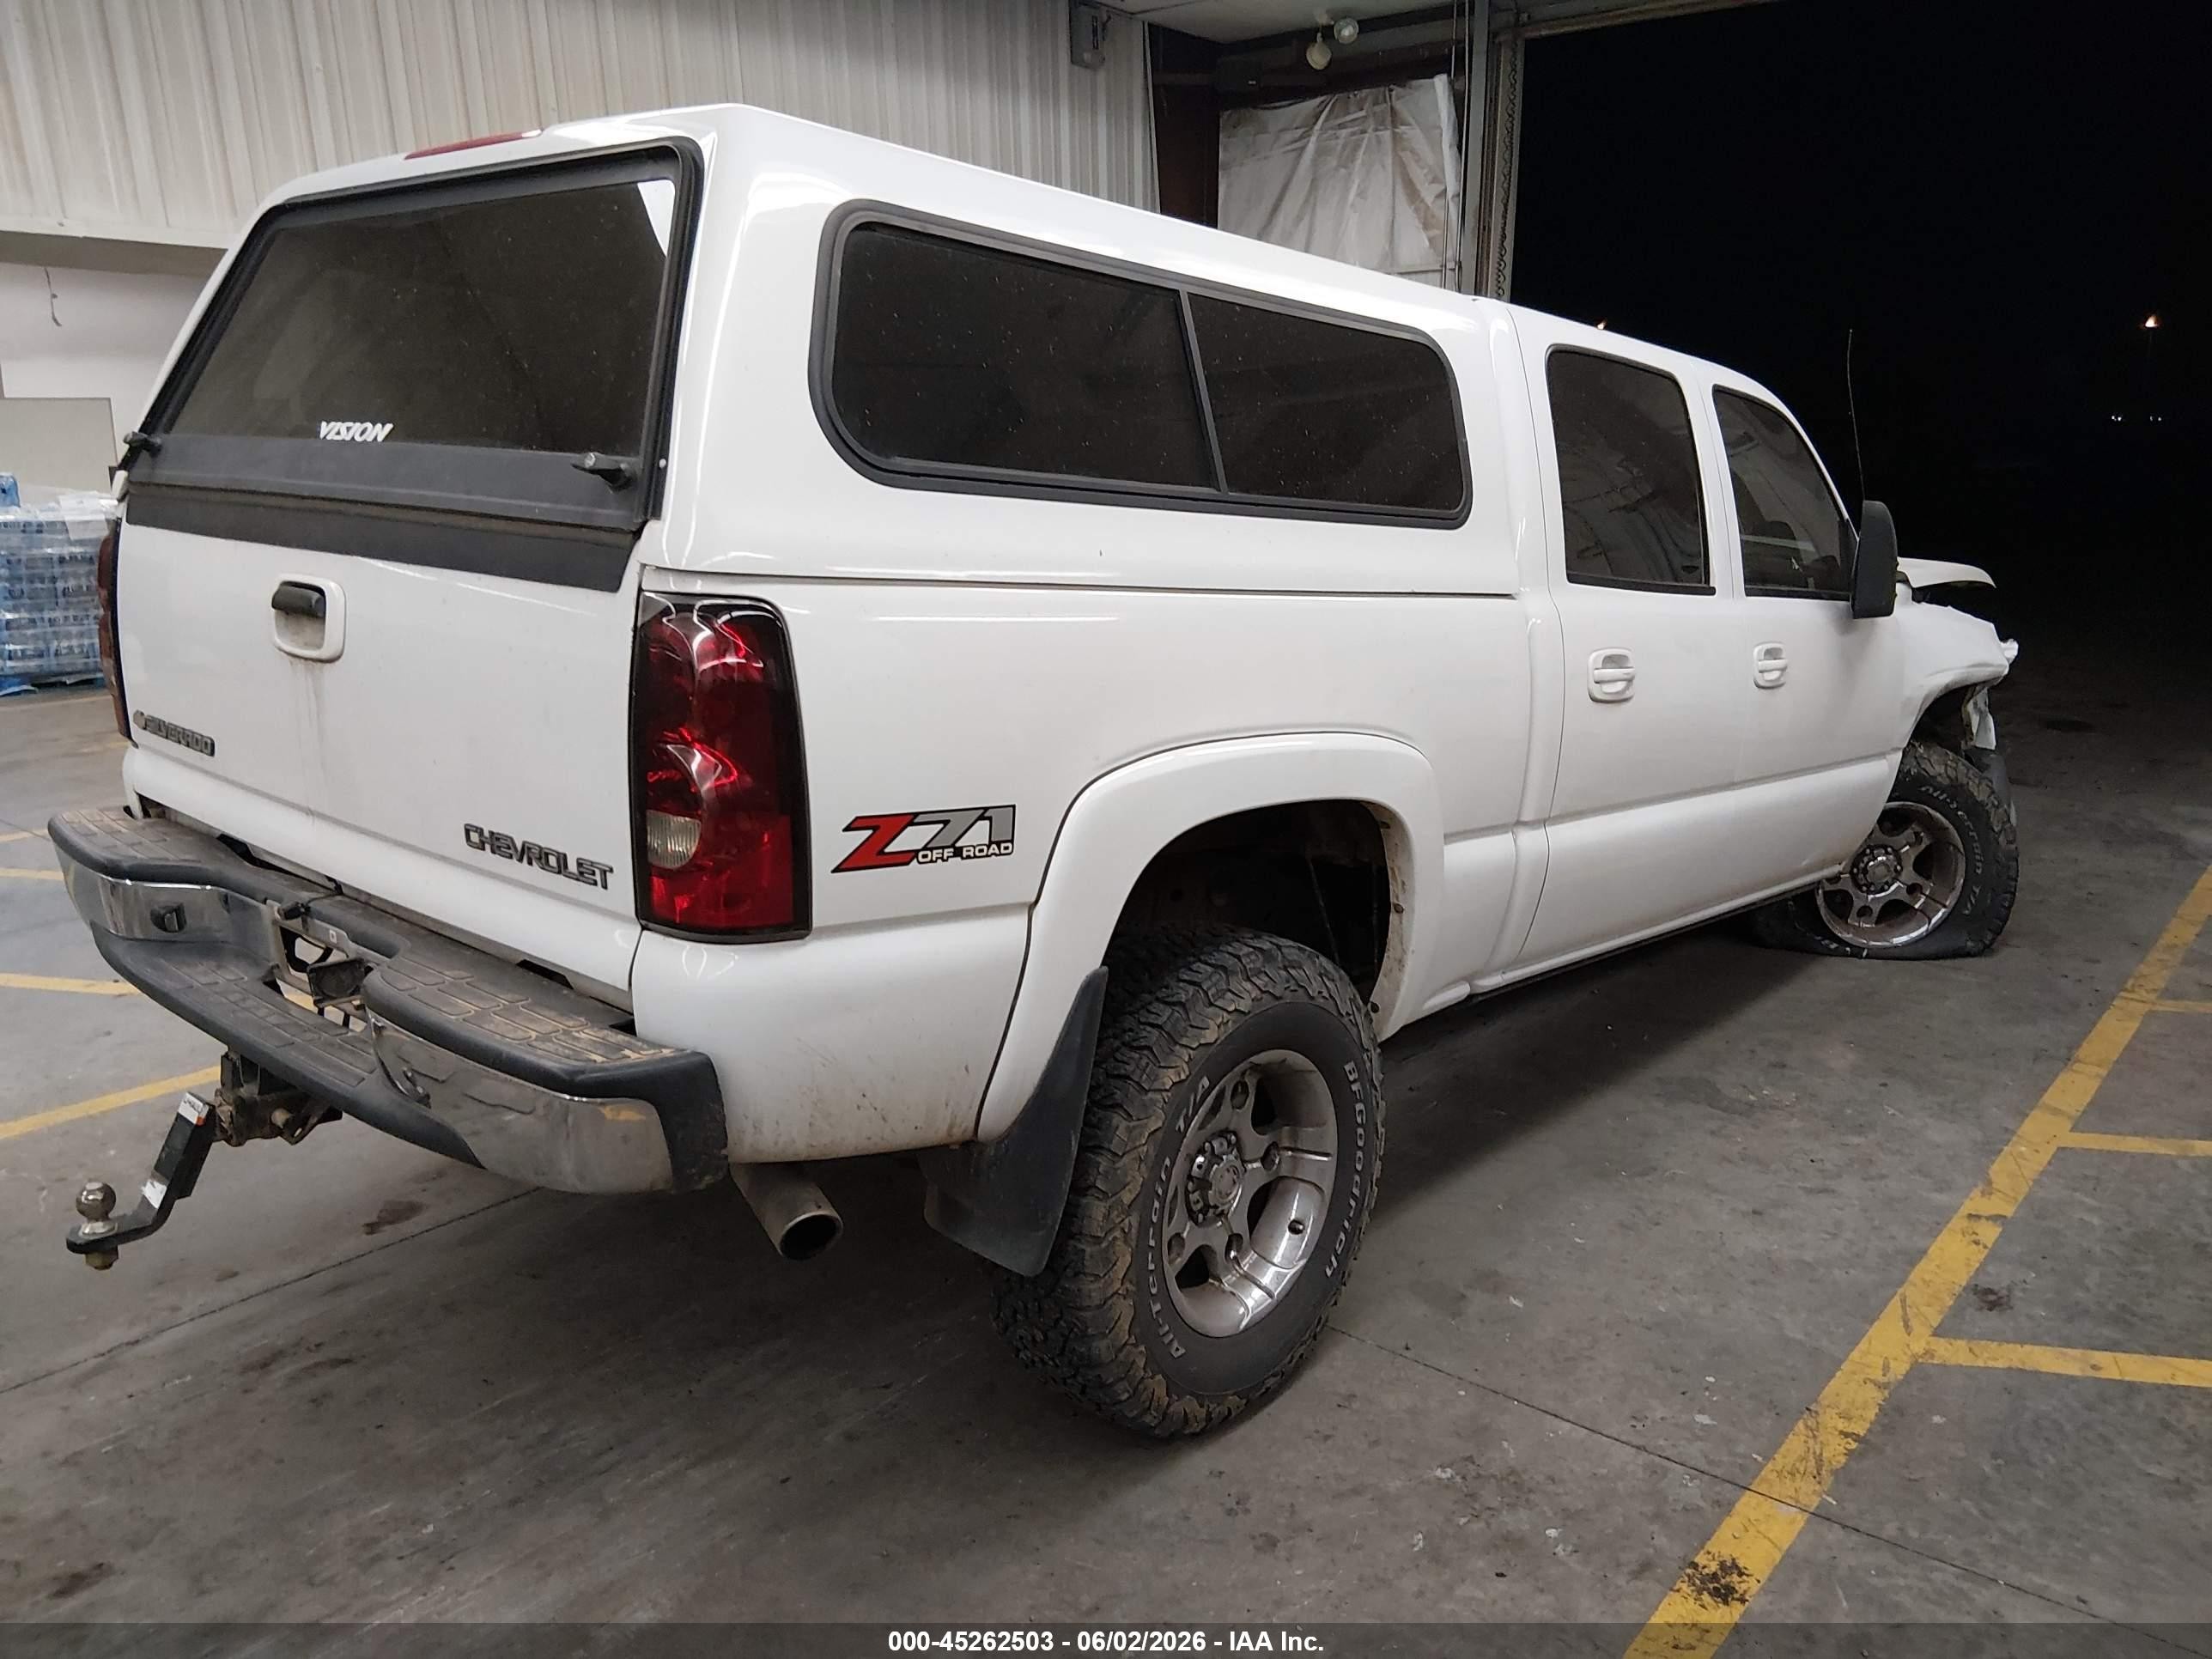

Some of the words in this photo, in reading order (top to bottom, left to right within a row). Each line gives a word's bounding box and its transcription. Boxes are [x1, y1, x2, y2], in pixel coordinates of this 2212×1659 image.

[319, 421, 394, 442] VISION
[464, 823, 614, 890] CHEVROLET
[831, 805, 1016, 873] Z71
[916, 847, 954, 864] OFF
[962, 842, 1013, 860] ROAD
